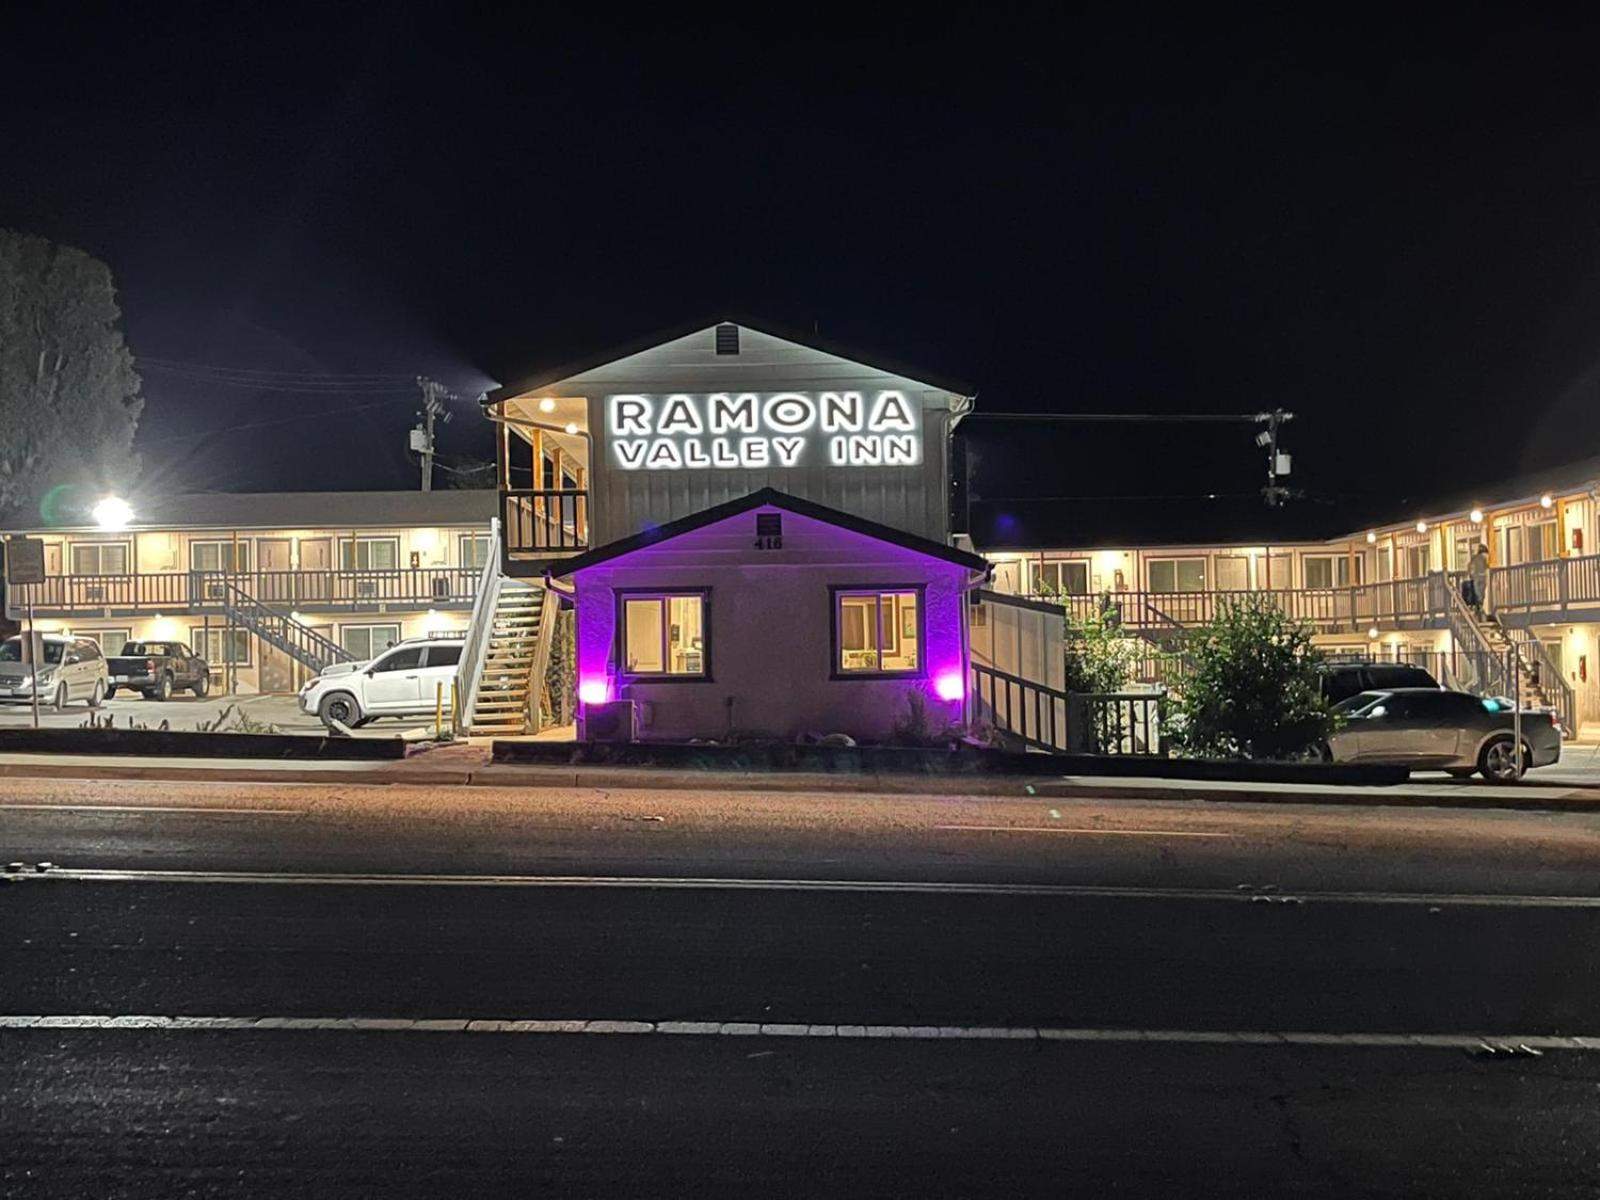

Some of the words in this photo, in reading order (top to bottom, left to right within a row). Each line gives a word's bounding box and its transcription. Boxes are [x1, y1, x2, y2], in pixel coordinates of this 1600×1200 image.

[614, 395, 912, 431] RAMONA
[615, 439, 803, 464] VALLEY
[834, 437, 913, 463] INN
